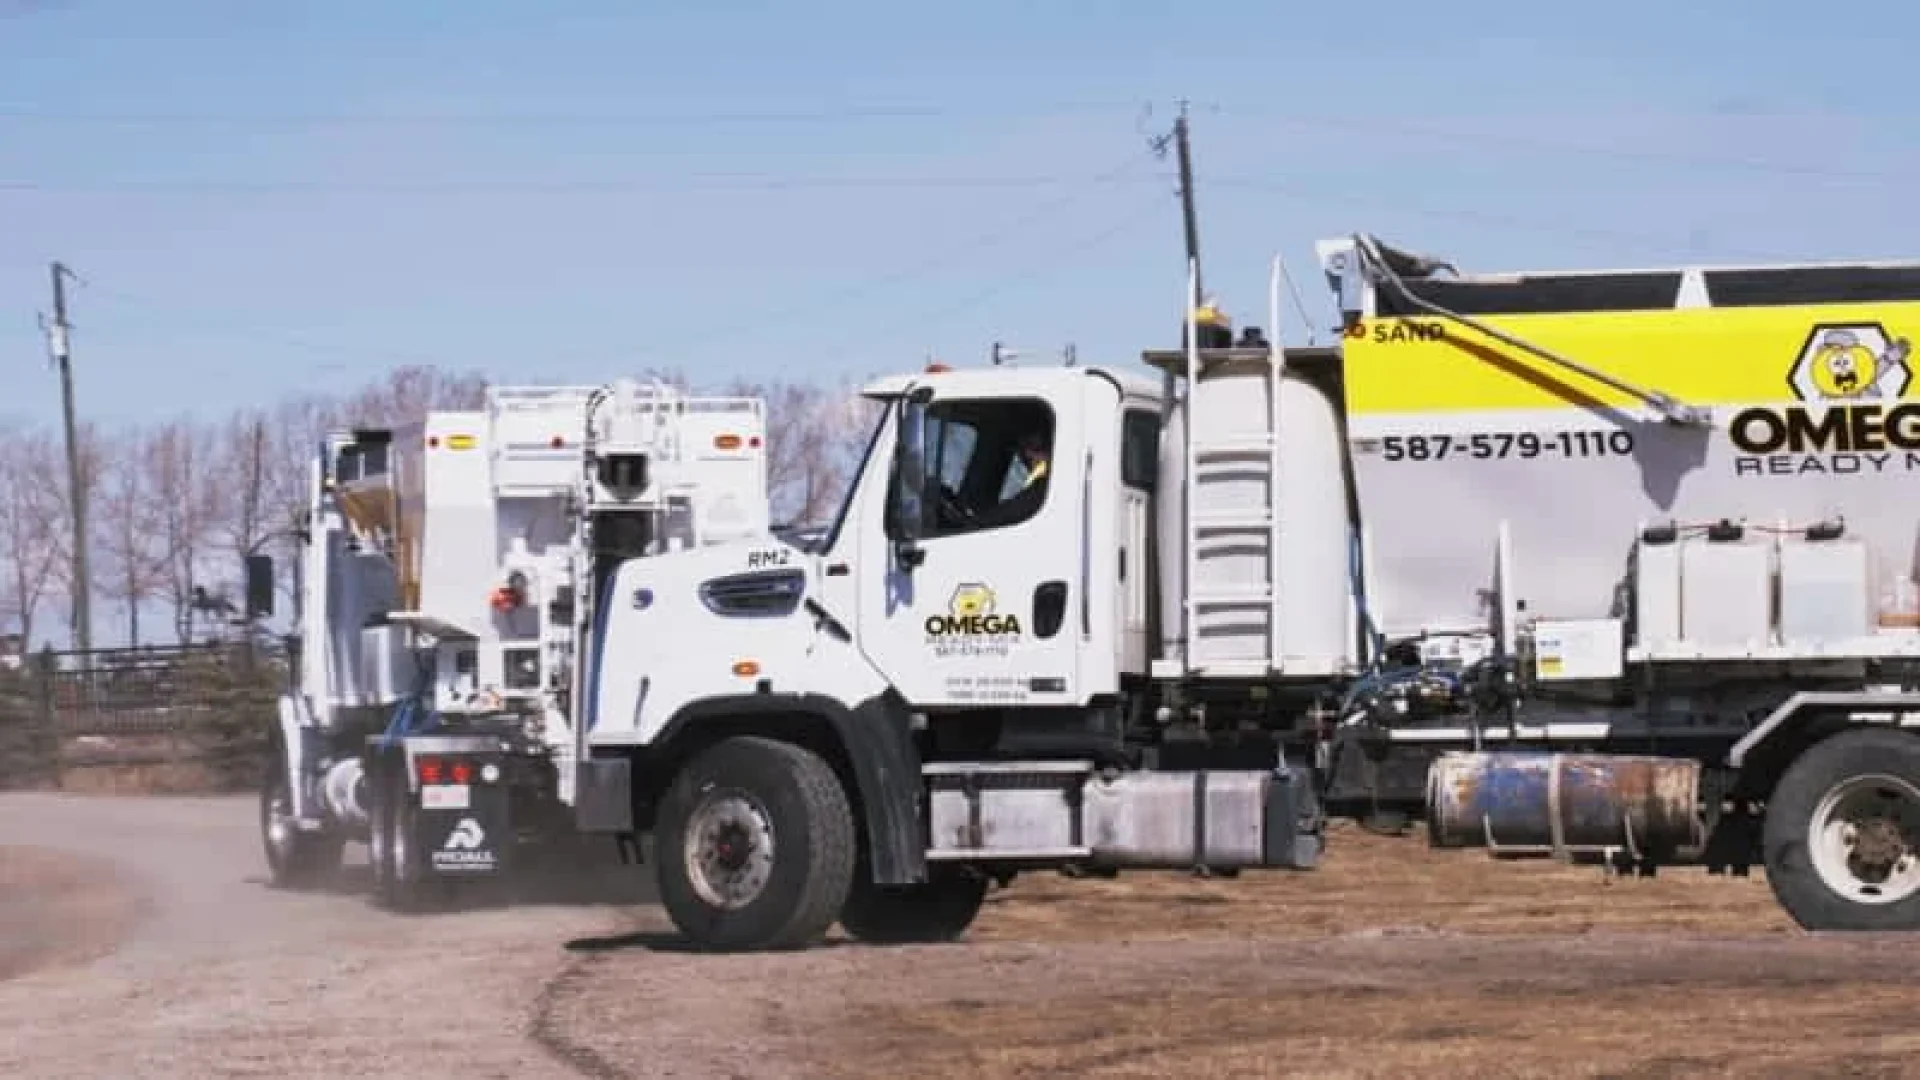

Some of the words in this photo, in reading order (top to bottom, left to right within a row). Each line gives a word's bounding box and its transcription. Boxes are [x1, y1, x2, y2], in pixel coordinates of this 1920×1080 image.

[1374, 323, 1444, 343] SAND
[1384, 431, 1634, 462] 587-579-1110
[1735, 453, 1893, 475] READY
[925, 614, 1021, 635] OMEGA
